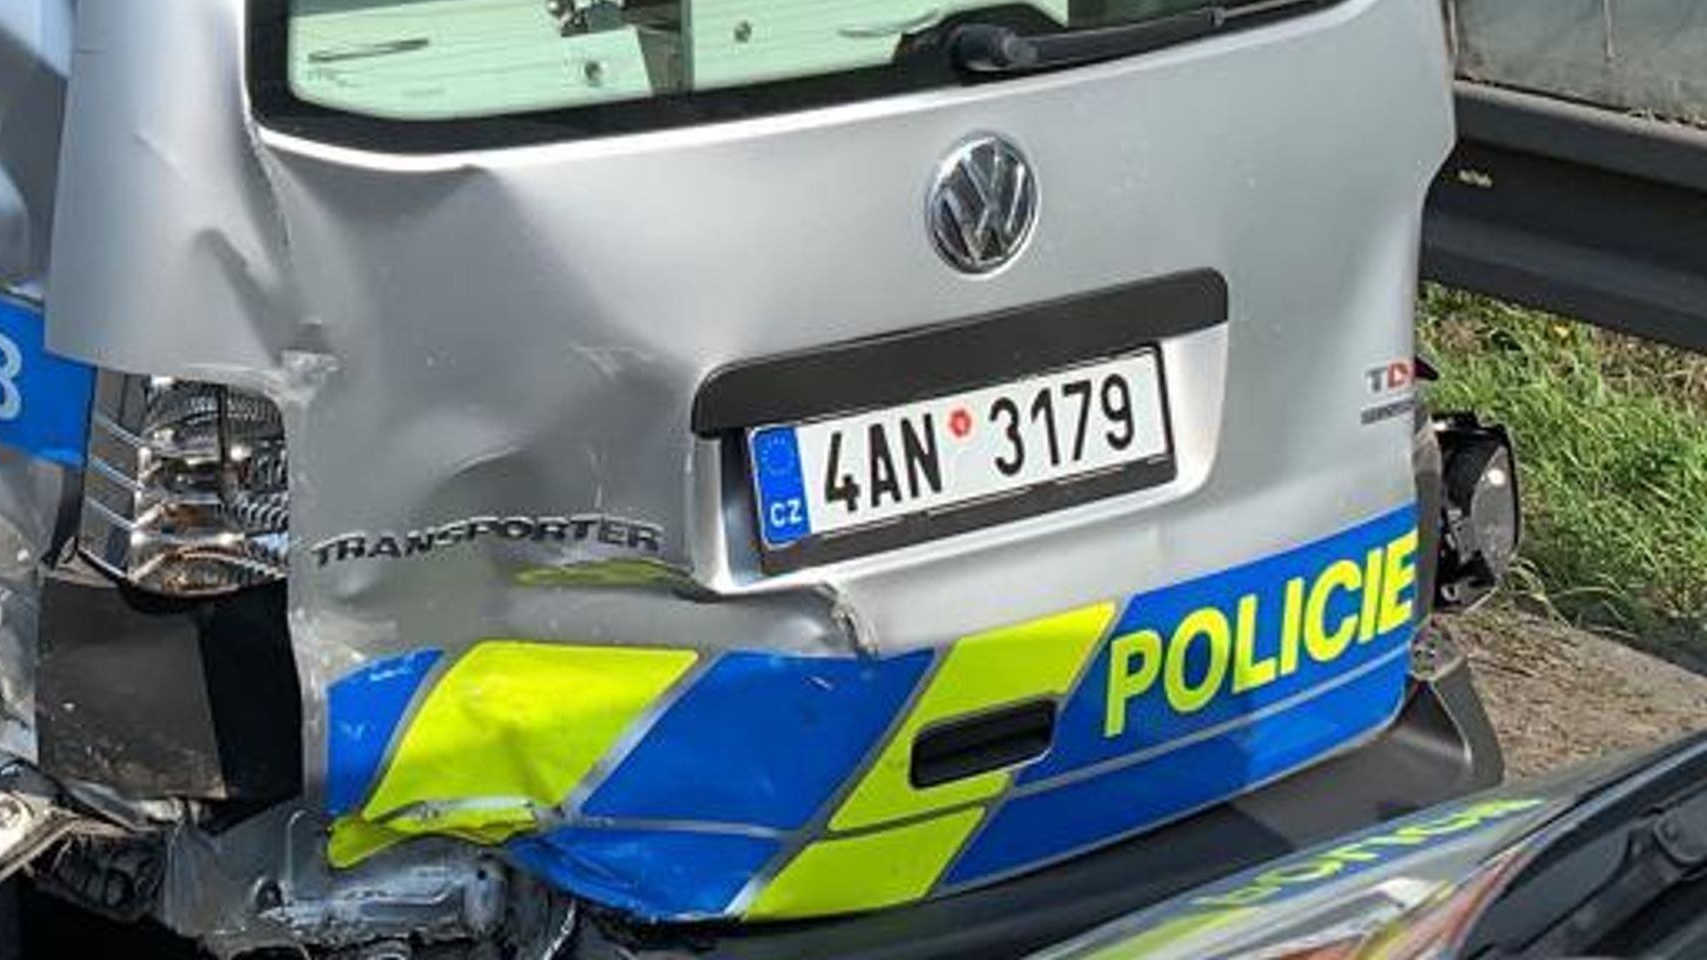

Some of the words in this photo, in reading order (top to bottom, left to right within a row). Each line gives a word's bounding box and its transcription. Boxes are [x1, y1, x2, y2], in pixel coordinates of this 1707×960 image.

[824, 413, 942, 512] 4AN
[990, 373, 1135, 477] 3179
[310, 513, 666, 569] TRANSPORTER
[770, 499, 802, 528] CZ
[1103, 527, 1419, 738] POLICIE
